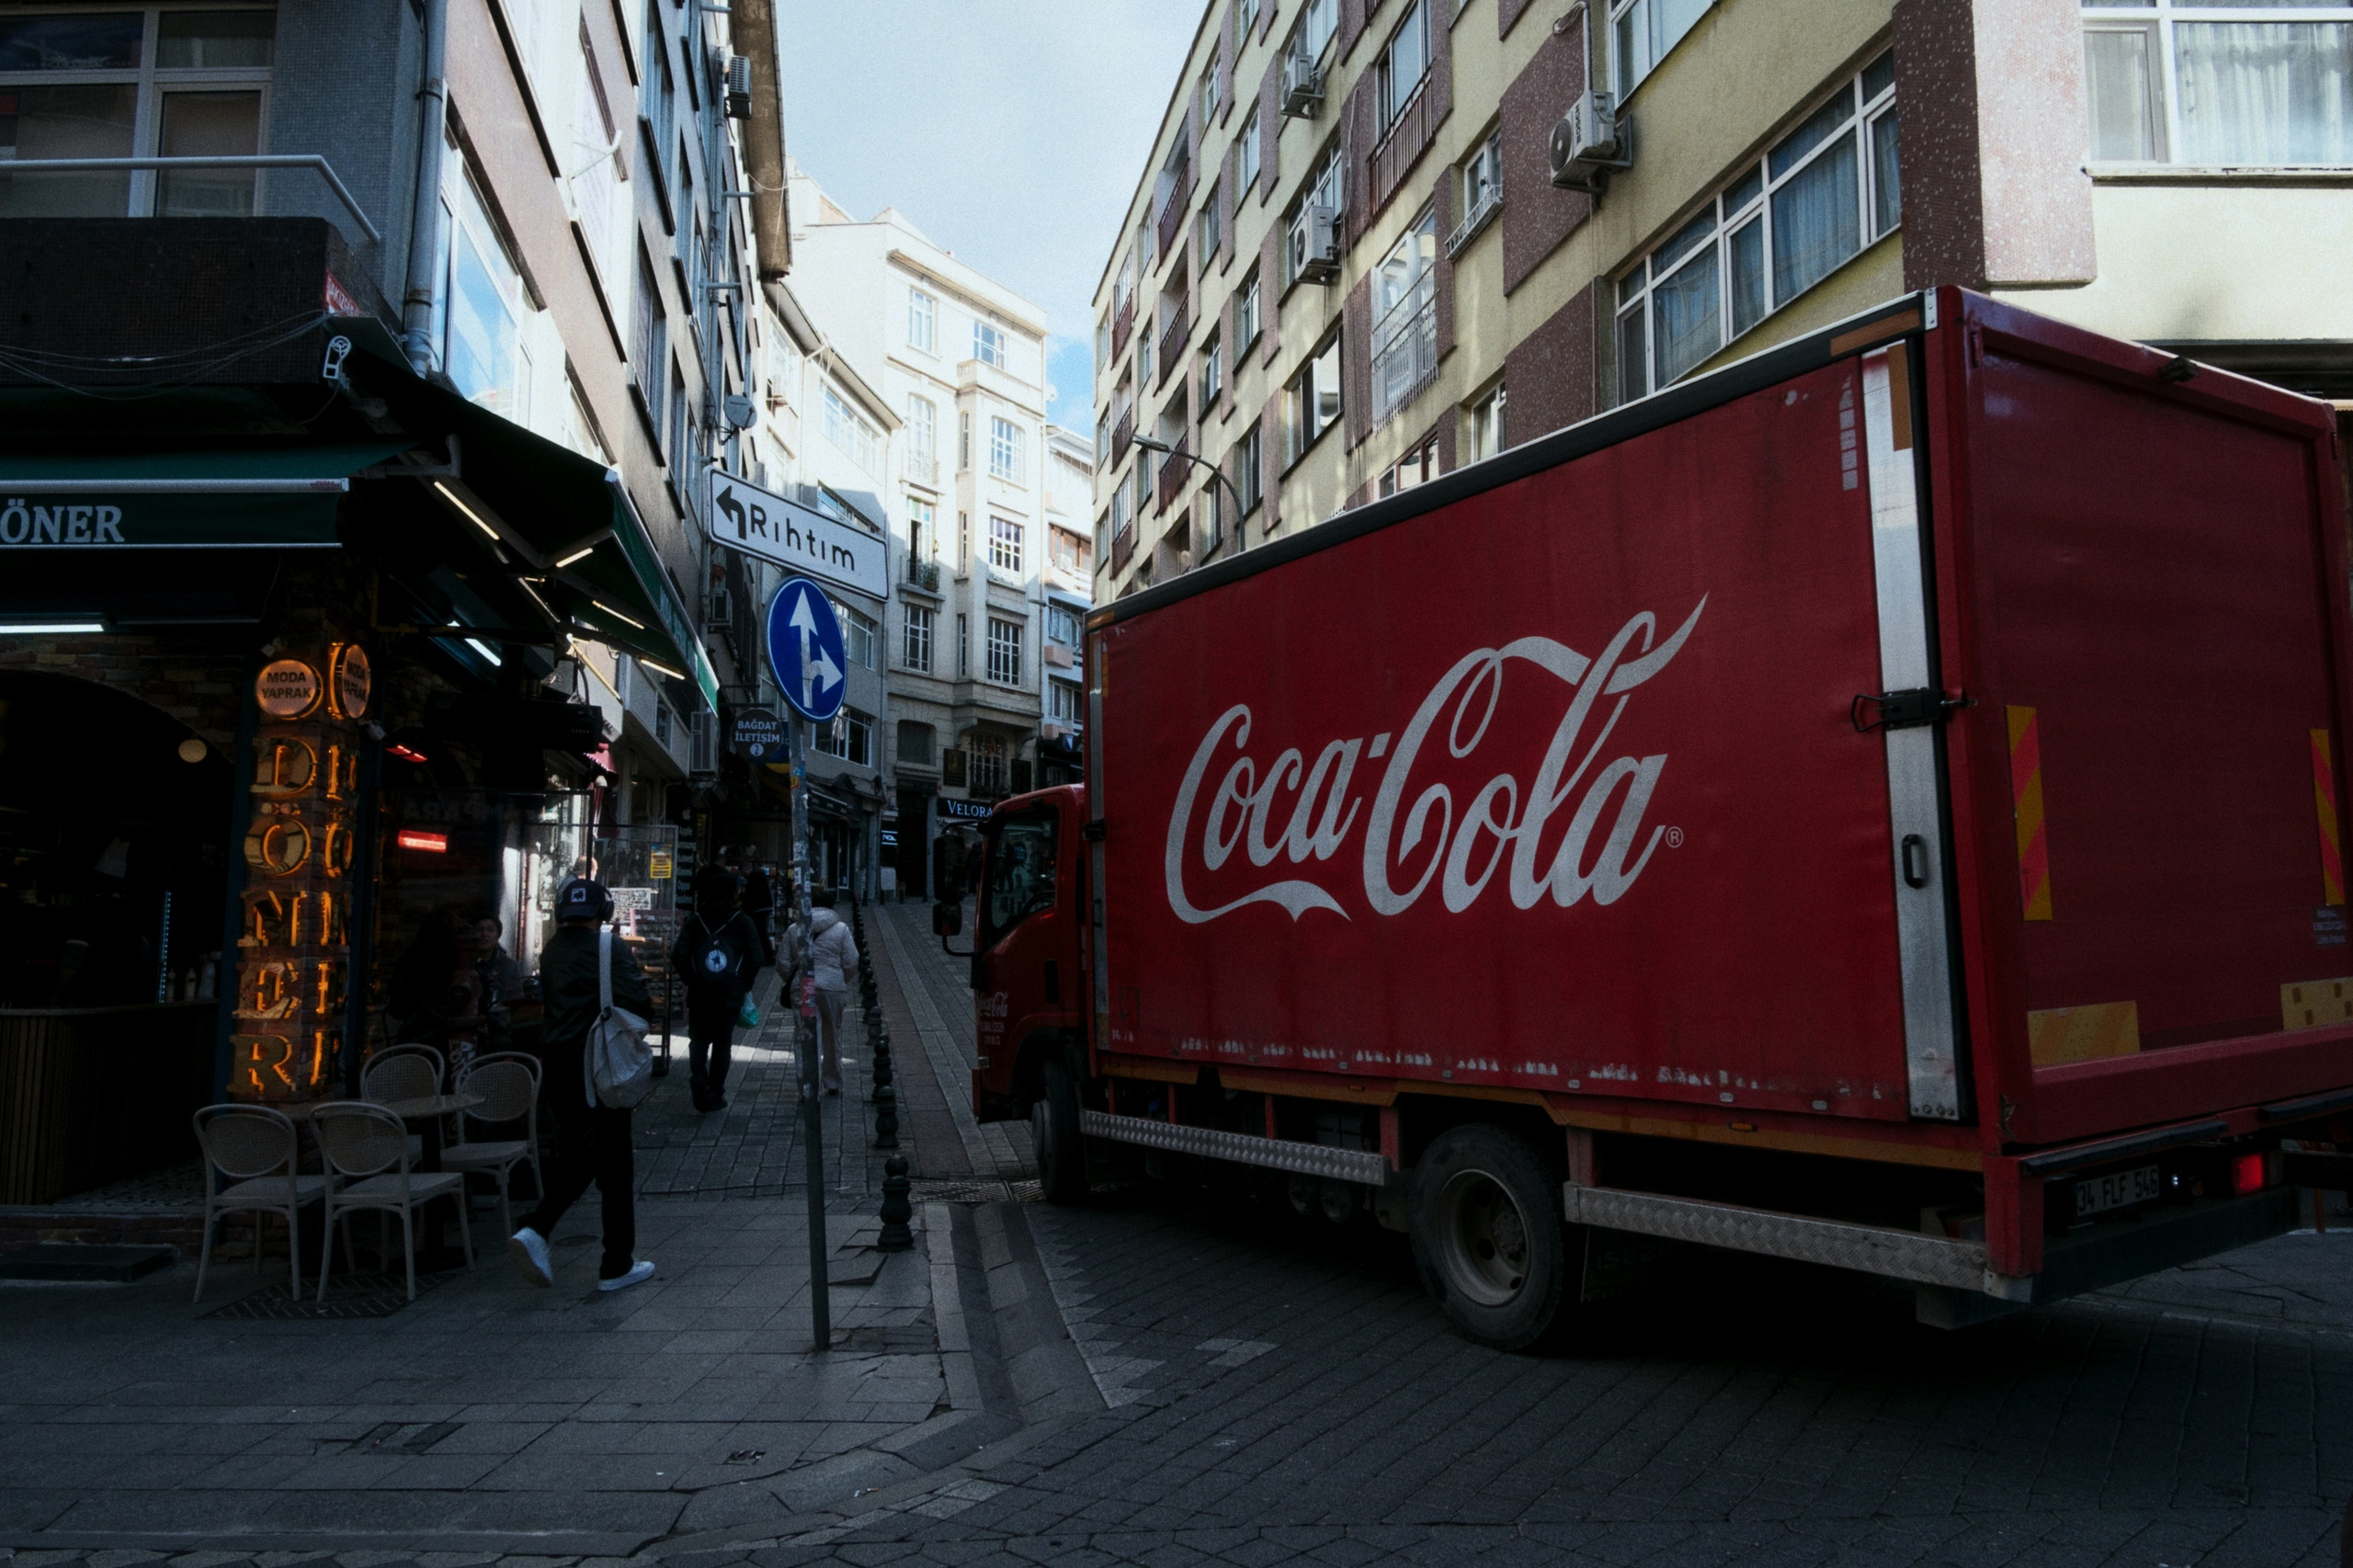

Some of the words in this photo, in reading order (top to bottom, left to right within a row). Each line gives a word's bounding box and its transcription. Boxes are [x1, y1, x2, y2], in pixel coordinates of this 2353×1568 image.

[0, 497, 126, 543] ÖNER
[267, 671, 306, 683] MODA
[261, 687, 312, 699] YAPRAK
[737, 718, 778, 731] BAĞDAT
[734, 730, 780, 744] İLETİŞİM
[1165, 590, 1710, 925] Coca-Cola
[226, 737, 319, 1095] DÖNER
[2078, 1183, 2095, 1212] 34
